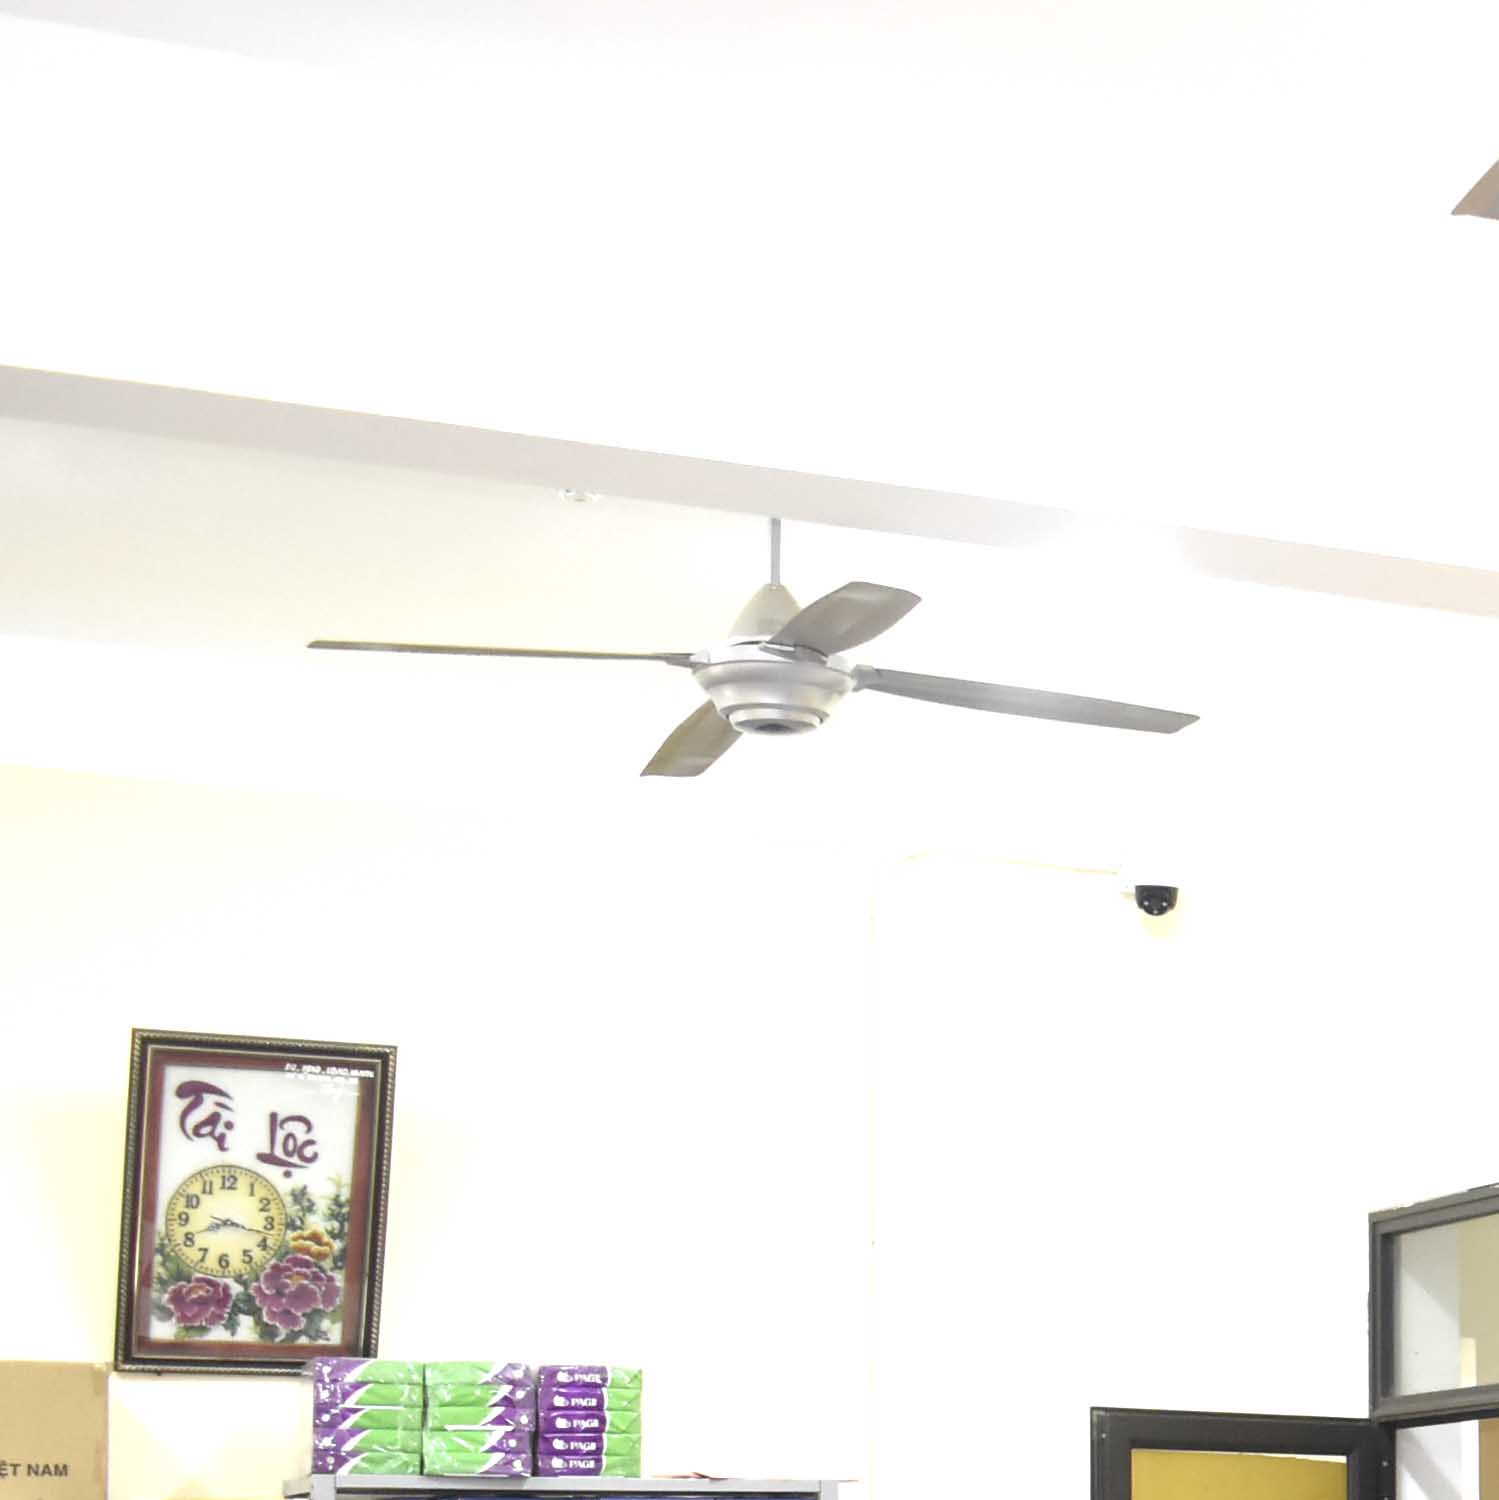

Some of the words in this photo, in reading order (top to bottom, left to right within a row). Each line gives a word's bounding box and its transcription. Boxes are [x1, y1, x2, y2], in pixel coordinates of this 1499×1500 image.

[202, 1180, 213, 1195] 11
[220, 1175, 238, 1190] 12
[249, 1183, 255, 1197] 1
[185, 1194, 200, 1209] 10
[259, 1198, 271, 1212] 2
[178, 1211, 189, 1226] 9
[264, 1216, 275, 1231] 3
[183, 1232, 195, 1247] 8
[257, 1236, 268, 1251] 4
[198, 1247, 208, 1262] 7
[218, 1253, 230, 1269] 6
[242, 1249, 253, 1265] 5
[27, 1462, 69, 1478] NAM
